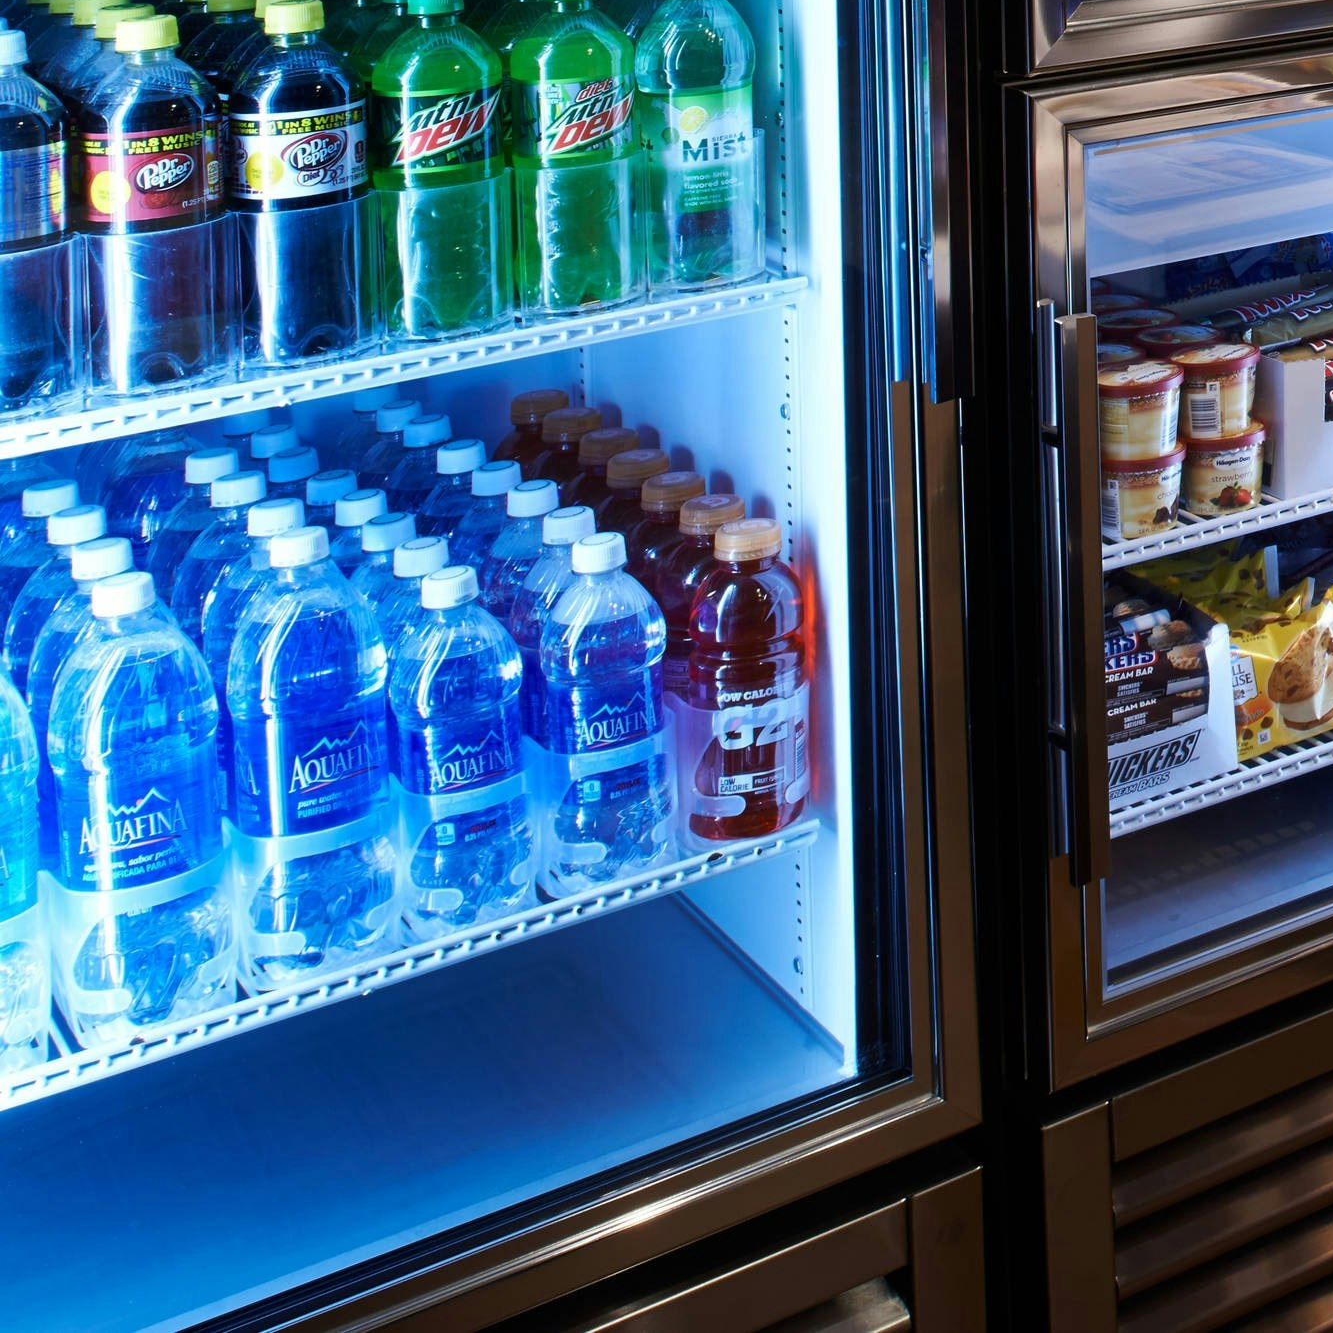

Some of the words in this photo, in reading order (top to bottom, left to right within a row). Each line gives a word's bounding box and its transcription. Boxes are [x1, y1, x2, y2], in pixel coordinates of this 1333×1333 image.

[575, 79, 614, 103] diet
[282, 126, 311, 136] FREE
[128, 145, 158, 155] FREE
[166, 139, 201, 152] MUSIC
[294, 139, 340, 169] Pepper
[311, 138, 328, 154] Dr
[682, 134, 748, 164] Mist
[156, 155, 179, 174] Dr
[138, 159, 193, 190] Pepper
[302, 171, 320, 182] Diet
[1134, 666, 1154, 678] BAR
[1137, 698, 1157, 710] BAR
[576, 708, 656, 748] AQUAFINA
[430, 743, 513, 793] AQUAFINA
[720, 777, 736, 786] LOW
[720, 782, 750, 794] CALORIE
[1137, 772, 1170, 793] BARS
[298, 806, 331, 818] PURIFIED
